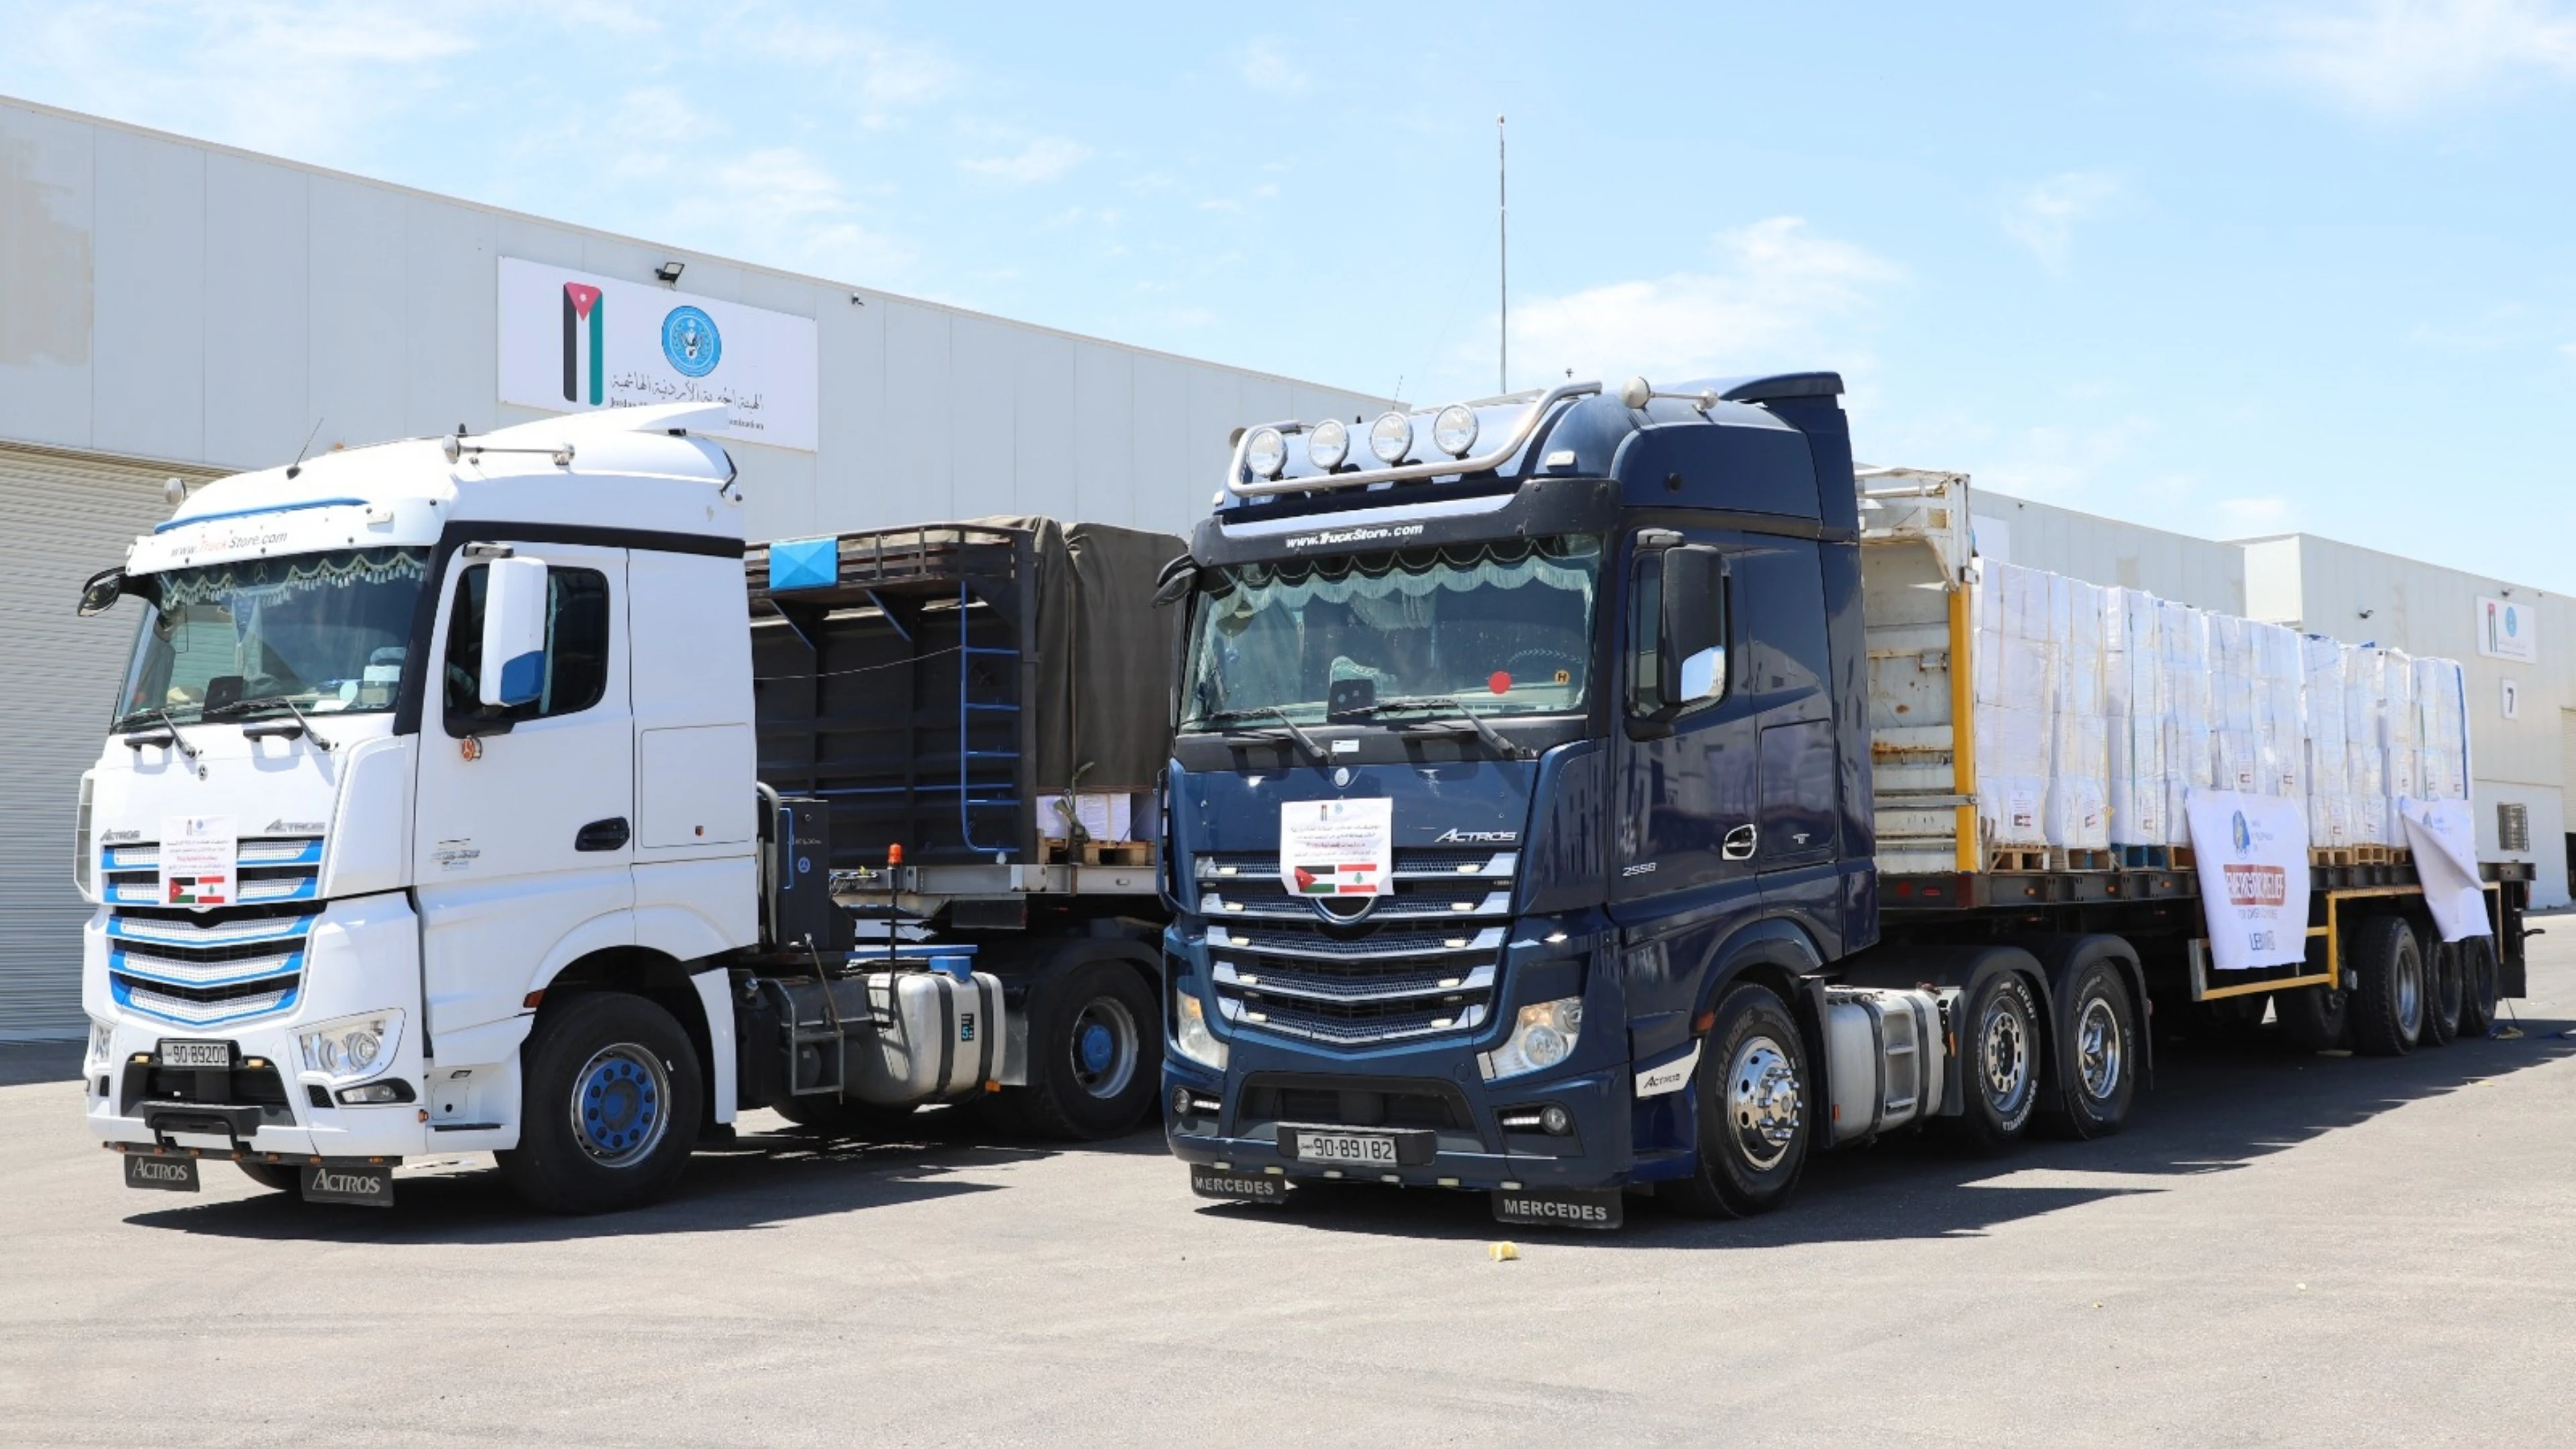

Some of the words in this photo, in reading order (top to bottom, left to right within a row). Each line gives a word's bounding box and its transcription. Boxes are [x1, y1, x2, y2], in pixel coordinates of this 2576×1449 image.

[1434, 828, 1517, 843] ACTROS
[1622, 862, 1657, 876] 2558
[132, 1157, 188, 1181] ACTROS
[312, 1169, 381, 1194] ACTROS
[1194, 1177, 1275, 1196] MERCEDES
[1503, 1198, 1607, 1222] MERCEDES
